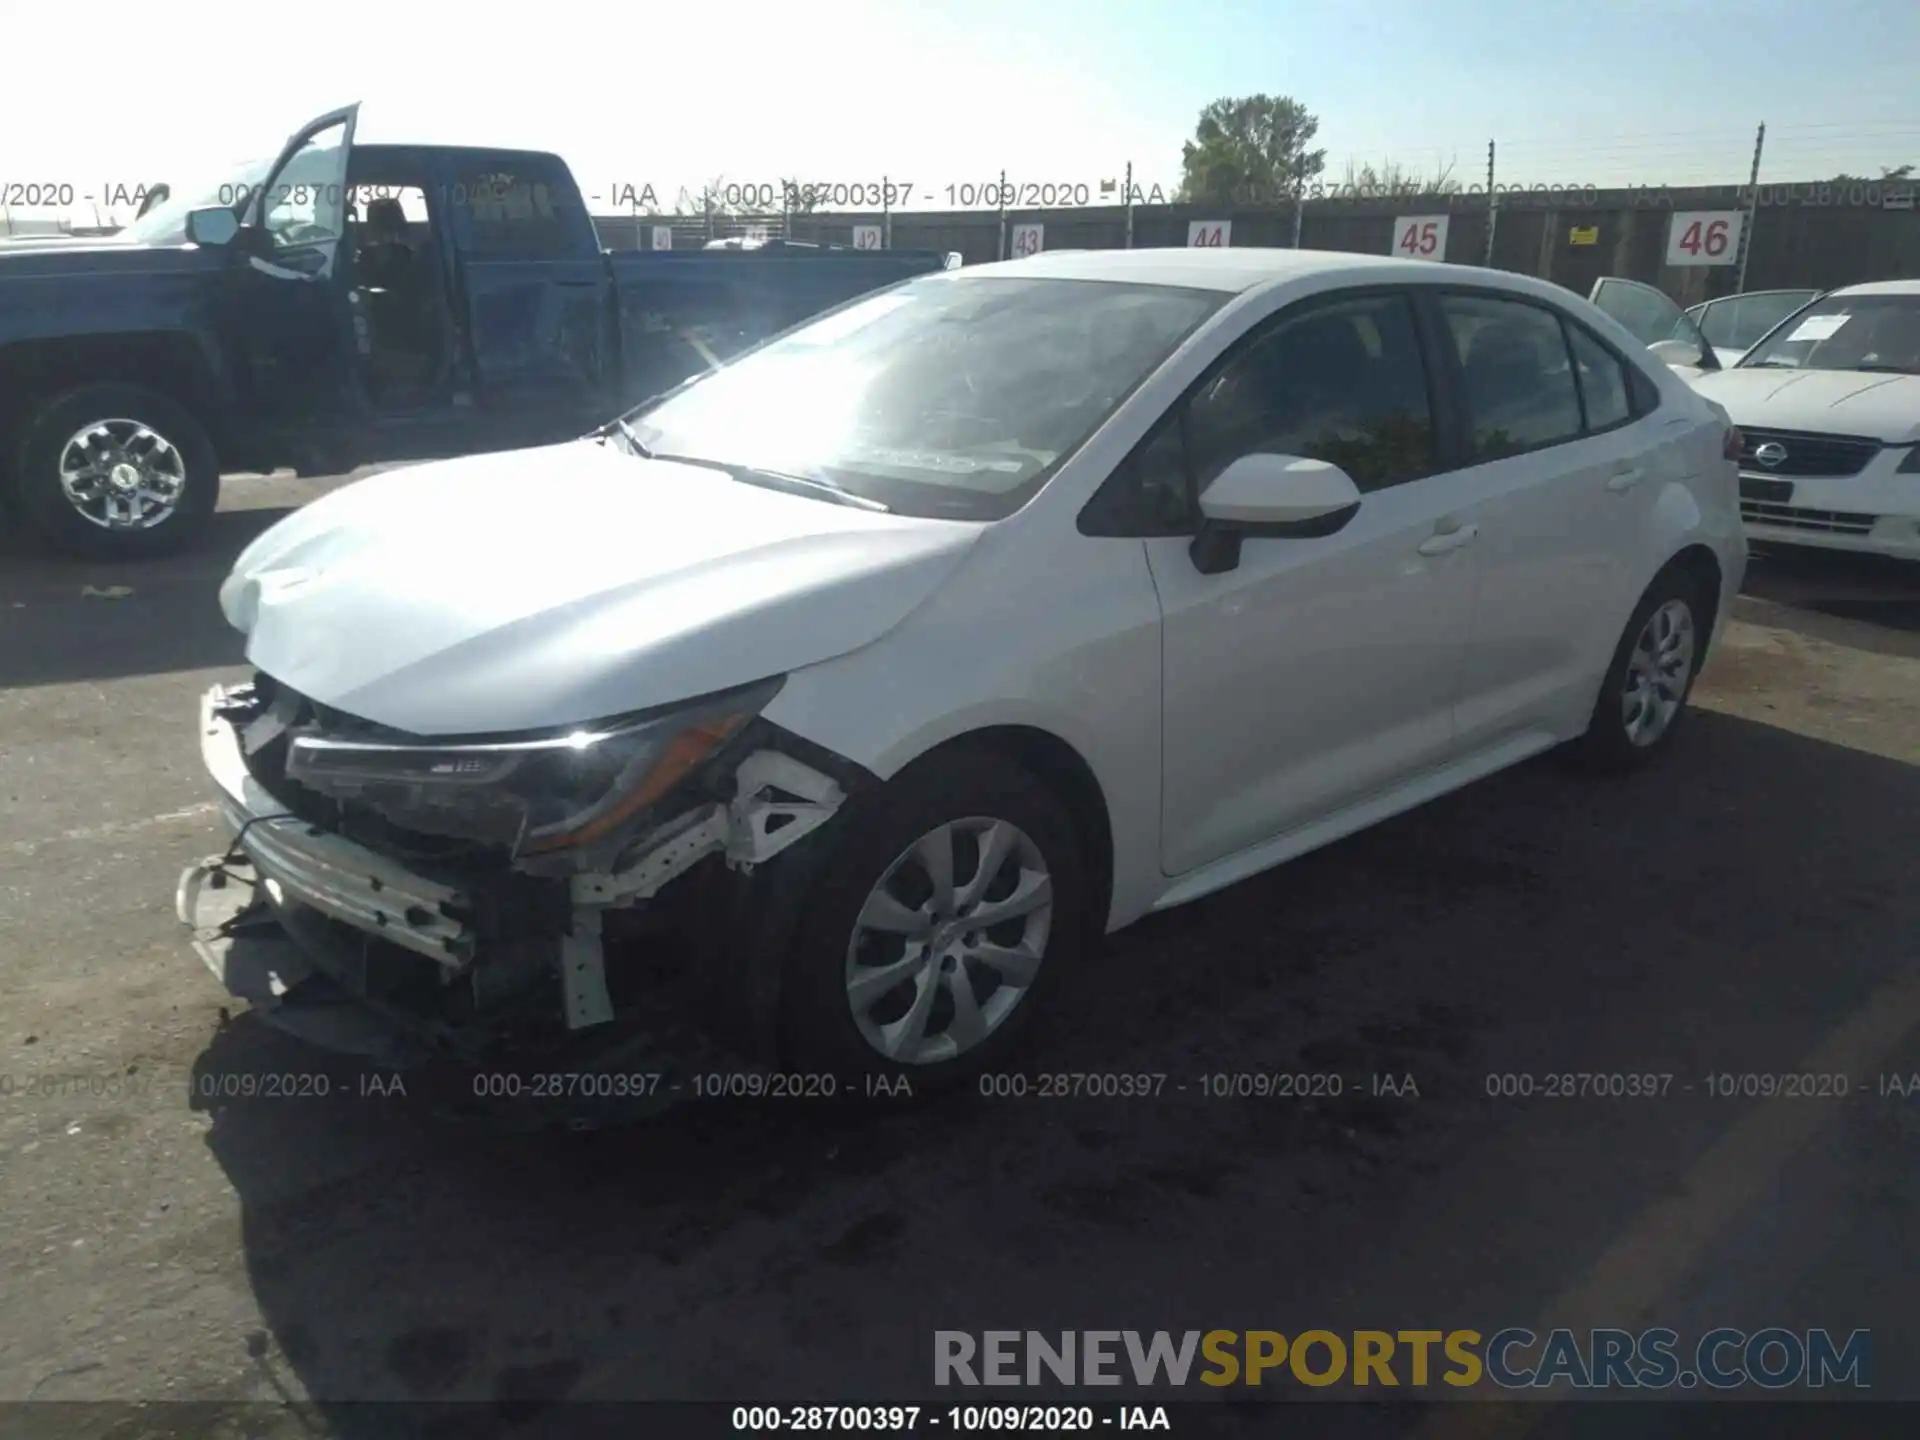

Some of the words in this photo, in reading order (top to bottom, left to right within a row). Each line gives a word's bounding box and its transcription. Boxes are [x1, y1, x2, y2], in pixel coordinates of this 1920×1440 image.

[858, 230, 877, 249] 42
[1016, 230, 1038, 255] 43
[1194, 227, 1222, 248] 44
[1400, 222, 1439, 255] 45
[1679, 220, 1729, 257] 46
